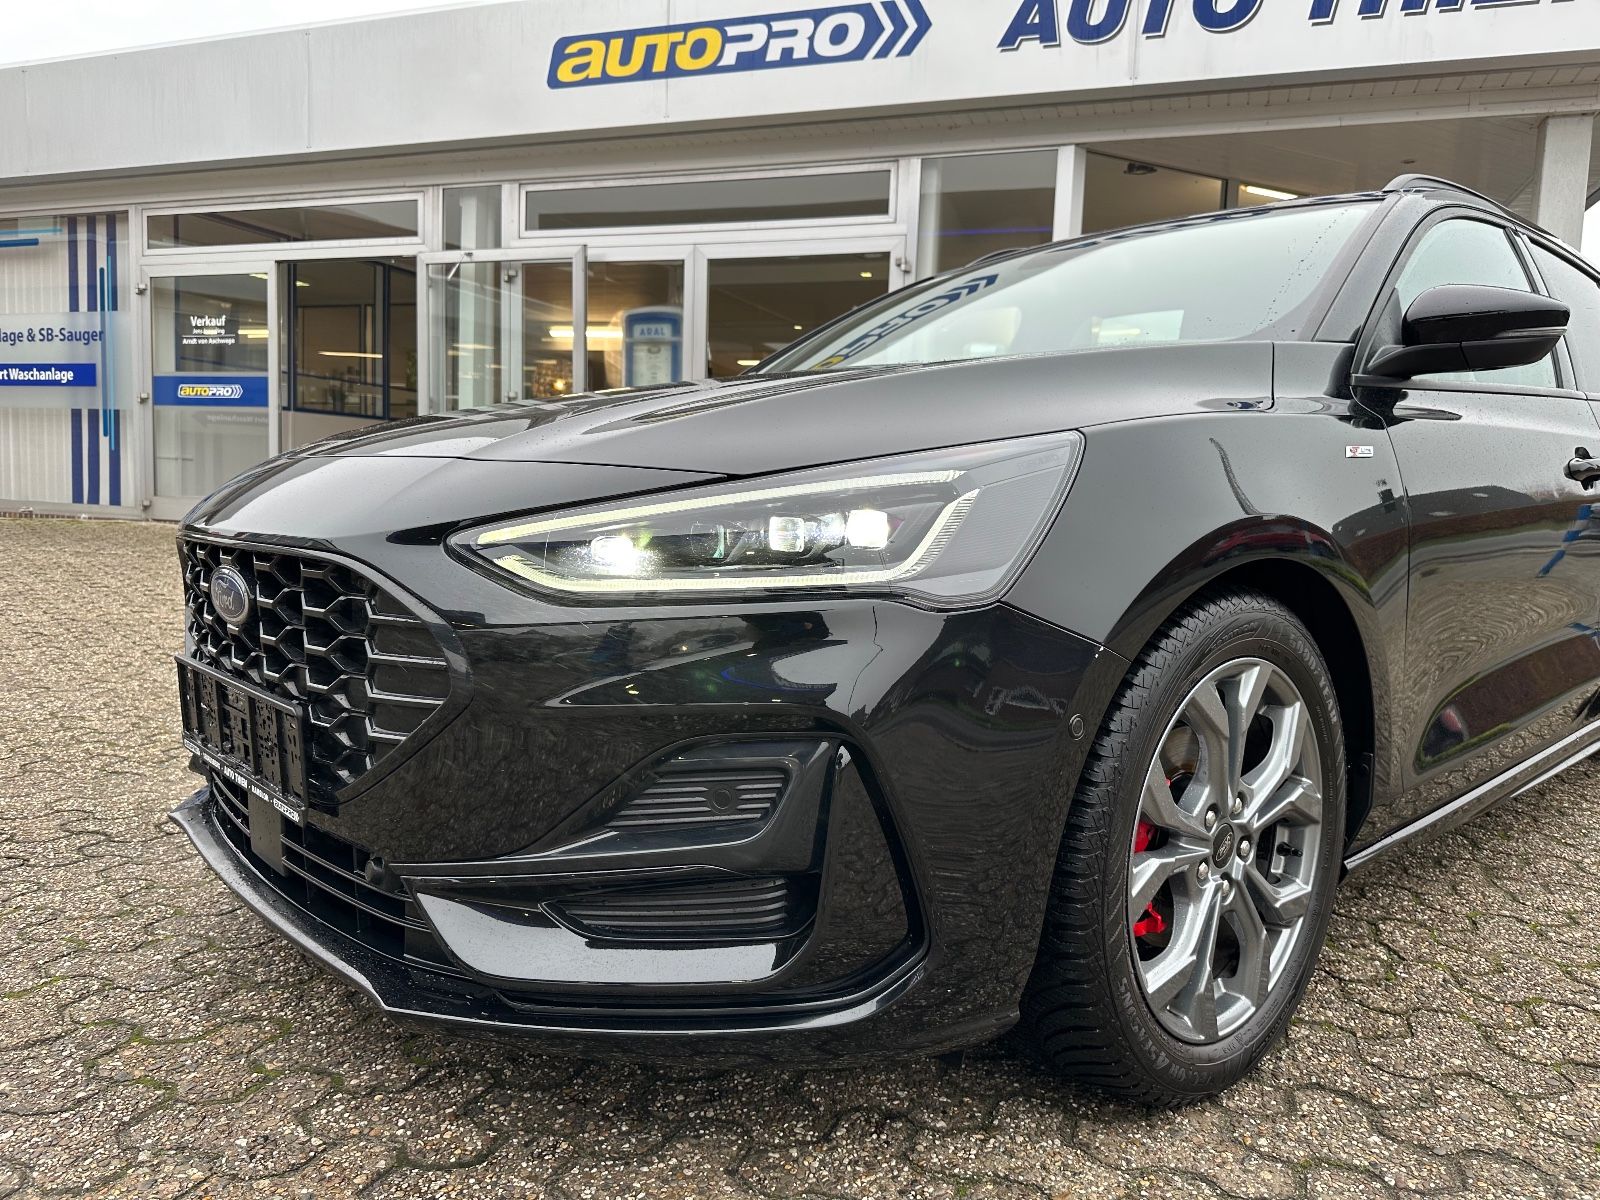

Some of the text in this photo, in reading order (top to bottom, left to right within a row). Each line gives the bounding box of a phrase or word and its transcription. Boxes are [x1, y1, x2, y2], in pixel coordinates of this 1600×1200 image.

[190, 314, 226, 327] Verkauf
[26, 327, 36, 342] &
[38, 327, 104, 346] SB-Sauger
[640, 327, 666, 337] ARAL
[8, 367, 74, 384] Waschanlage
